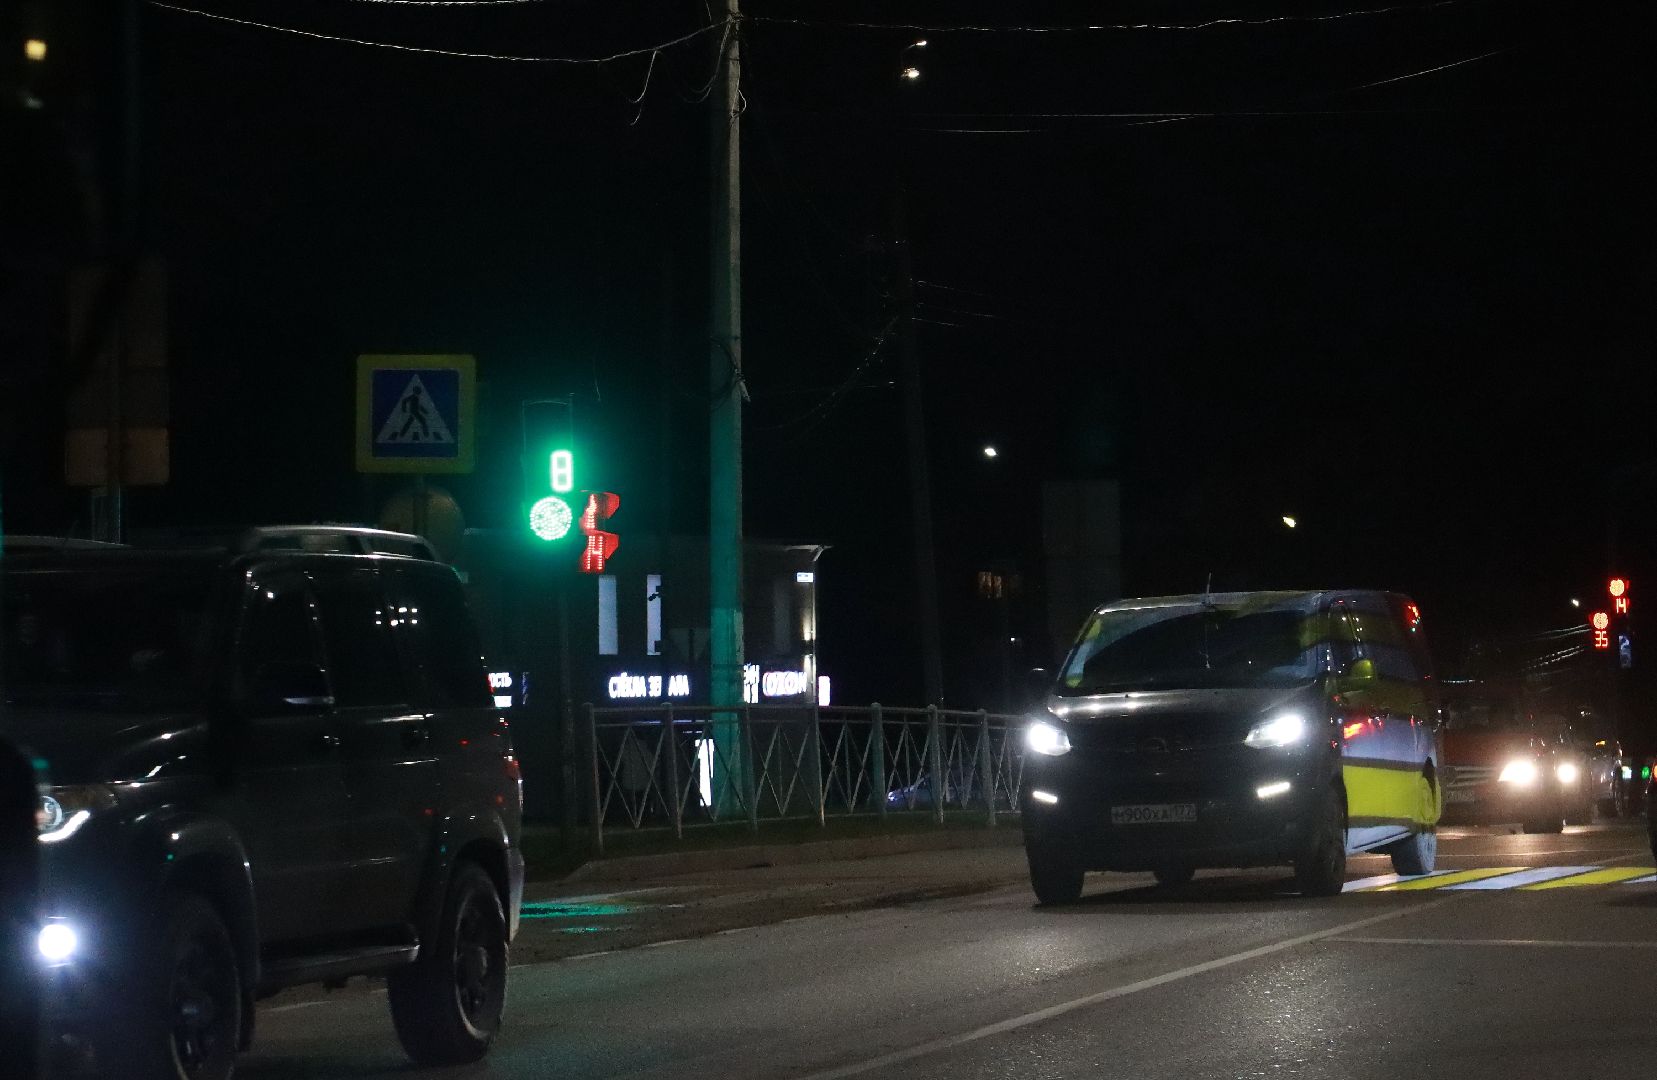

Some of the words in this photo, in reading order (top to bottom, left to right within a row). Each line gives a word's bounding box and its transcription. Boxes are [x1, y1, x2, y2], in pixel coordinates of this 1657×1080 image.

[550, 449, 573, 493] 8
[1616, 598, 1627, 613] 14
[1594, 630, 1608, 648] 35
